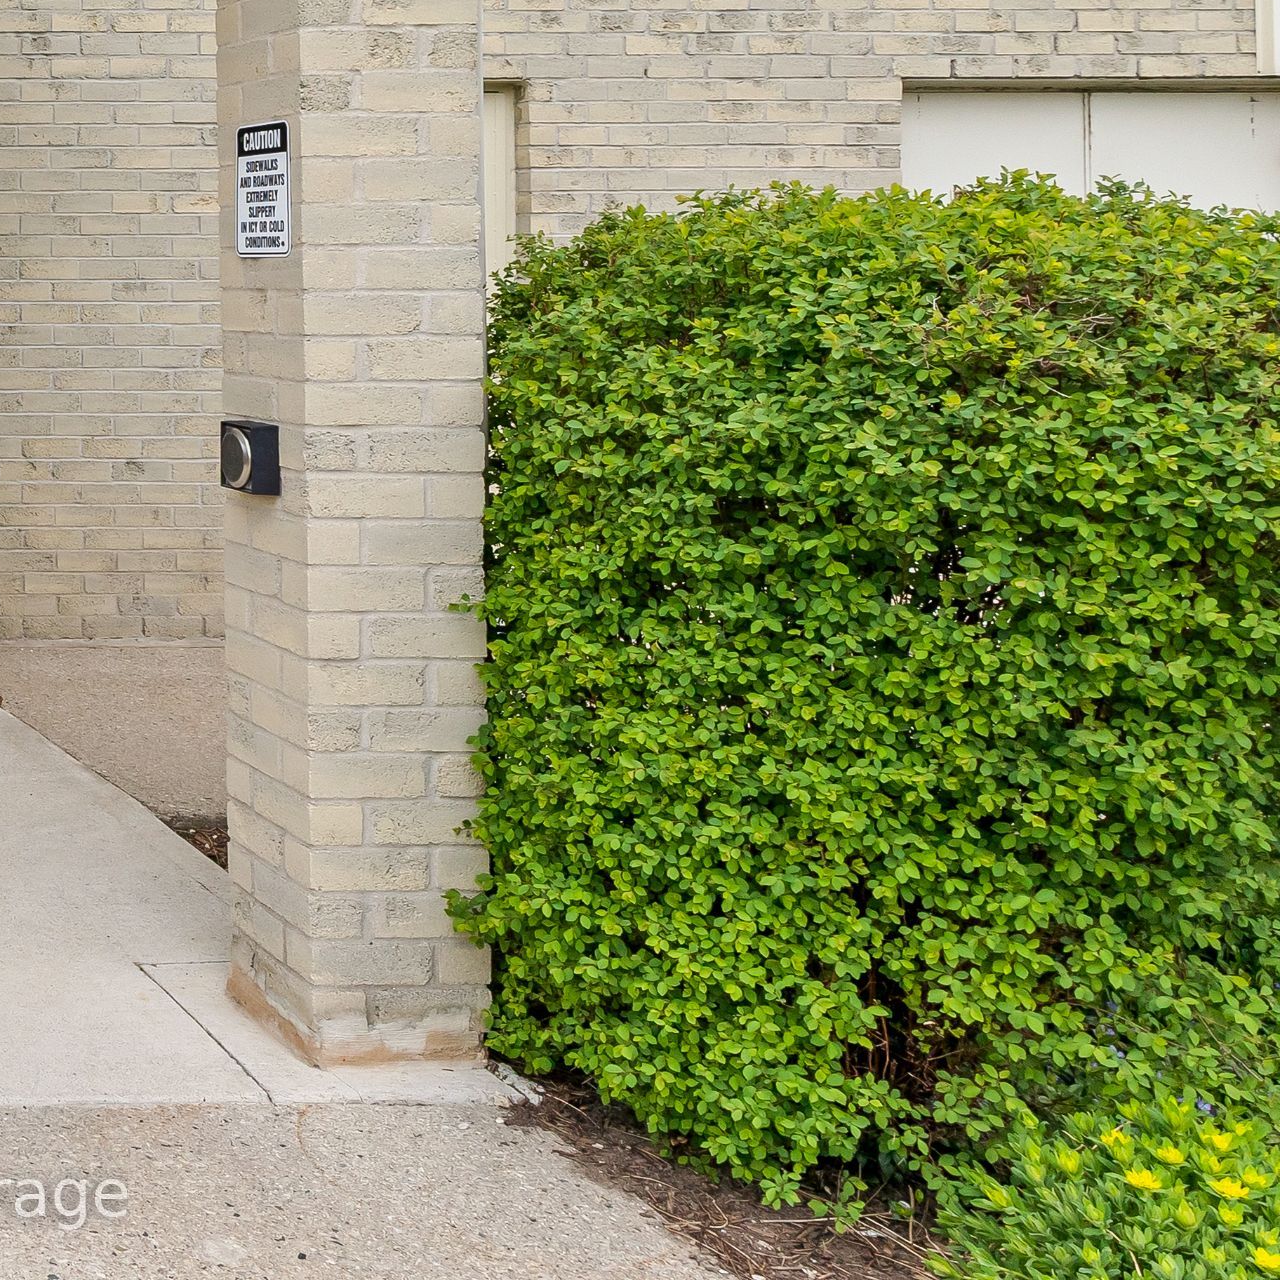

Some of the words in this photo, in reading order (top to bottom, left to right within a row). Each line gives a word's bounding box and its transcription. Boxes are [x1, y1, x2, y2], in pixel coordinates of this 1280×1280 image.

[243, 128, 281, 152] CAUTION
[245, 158, 279, 173] SIDEWALKS
[240, 175, 251, 189] AND
[253, 173, 285, 188] ROADWAYS
[246, 189, 278, 204] EXTREMELY
[248, 205, 276, 218] SLIPPERY
[240, 221, 247, 234] IN
[248, 221, 258, 234] ICY
[259, 221, 267, 233] OR
[268, 220, 285, 233] COLD
